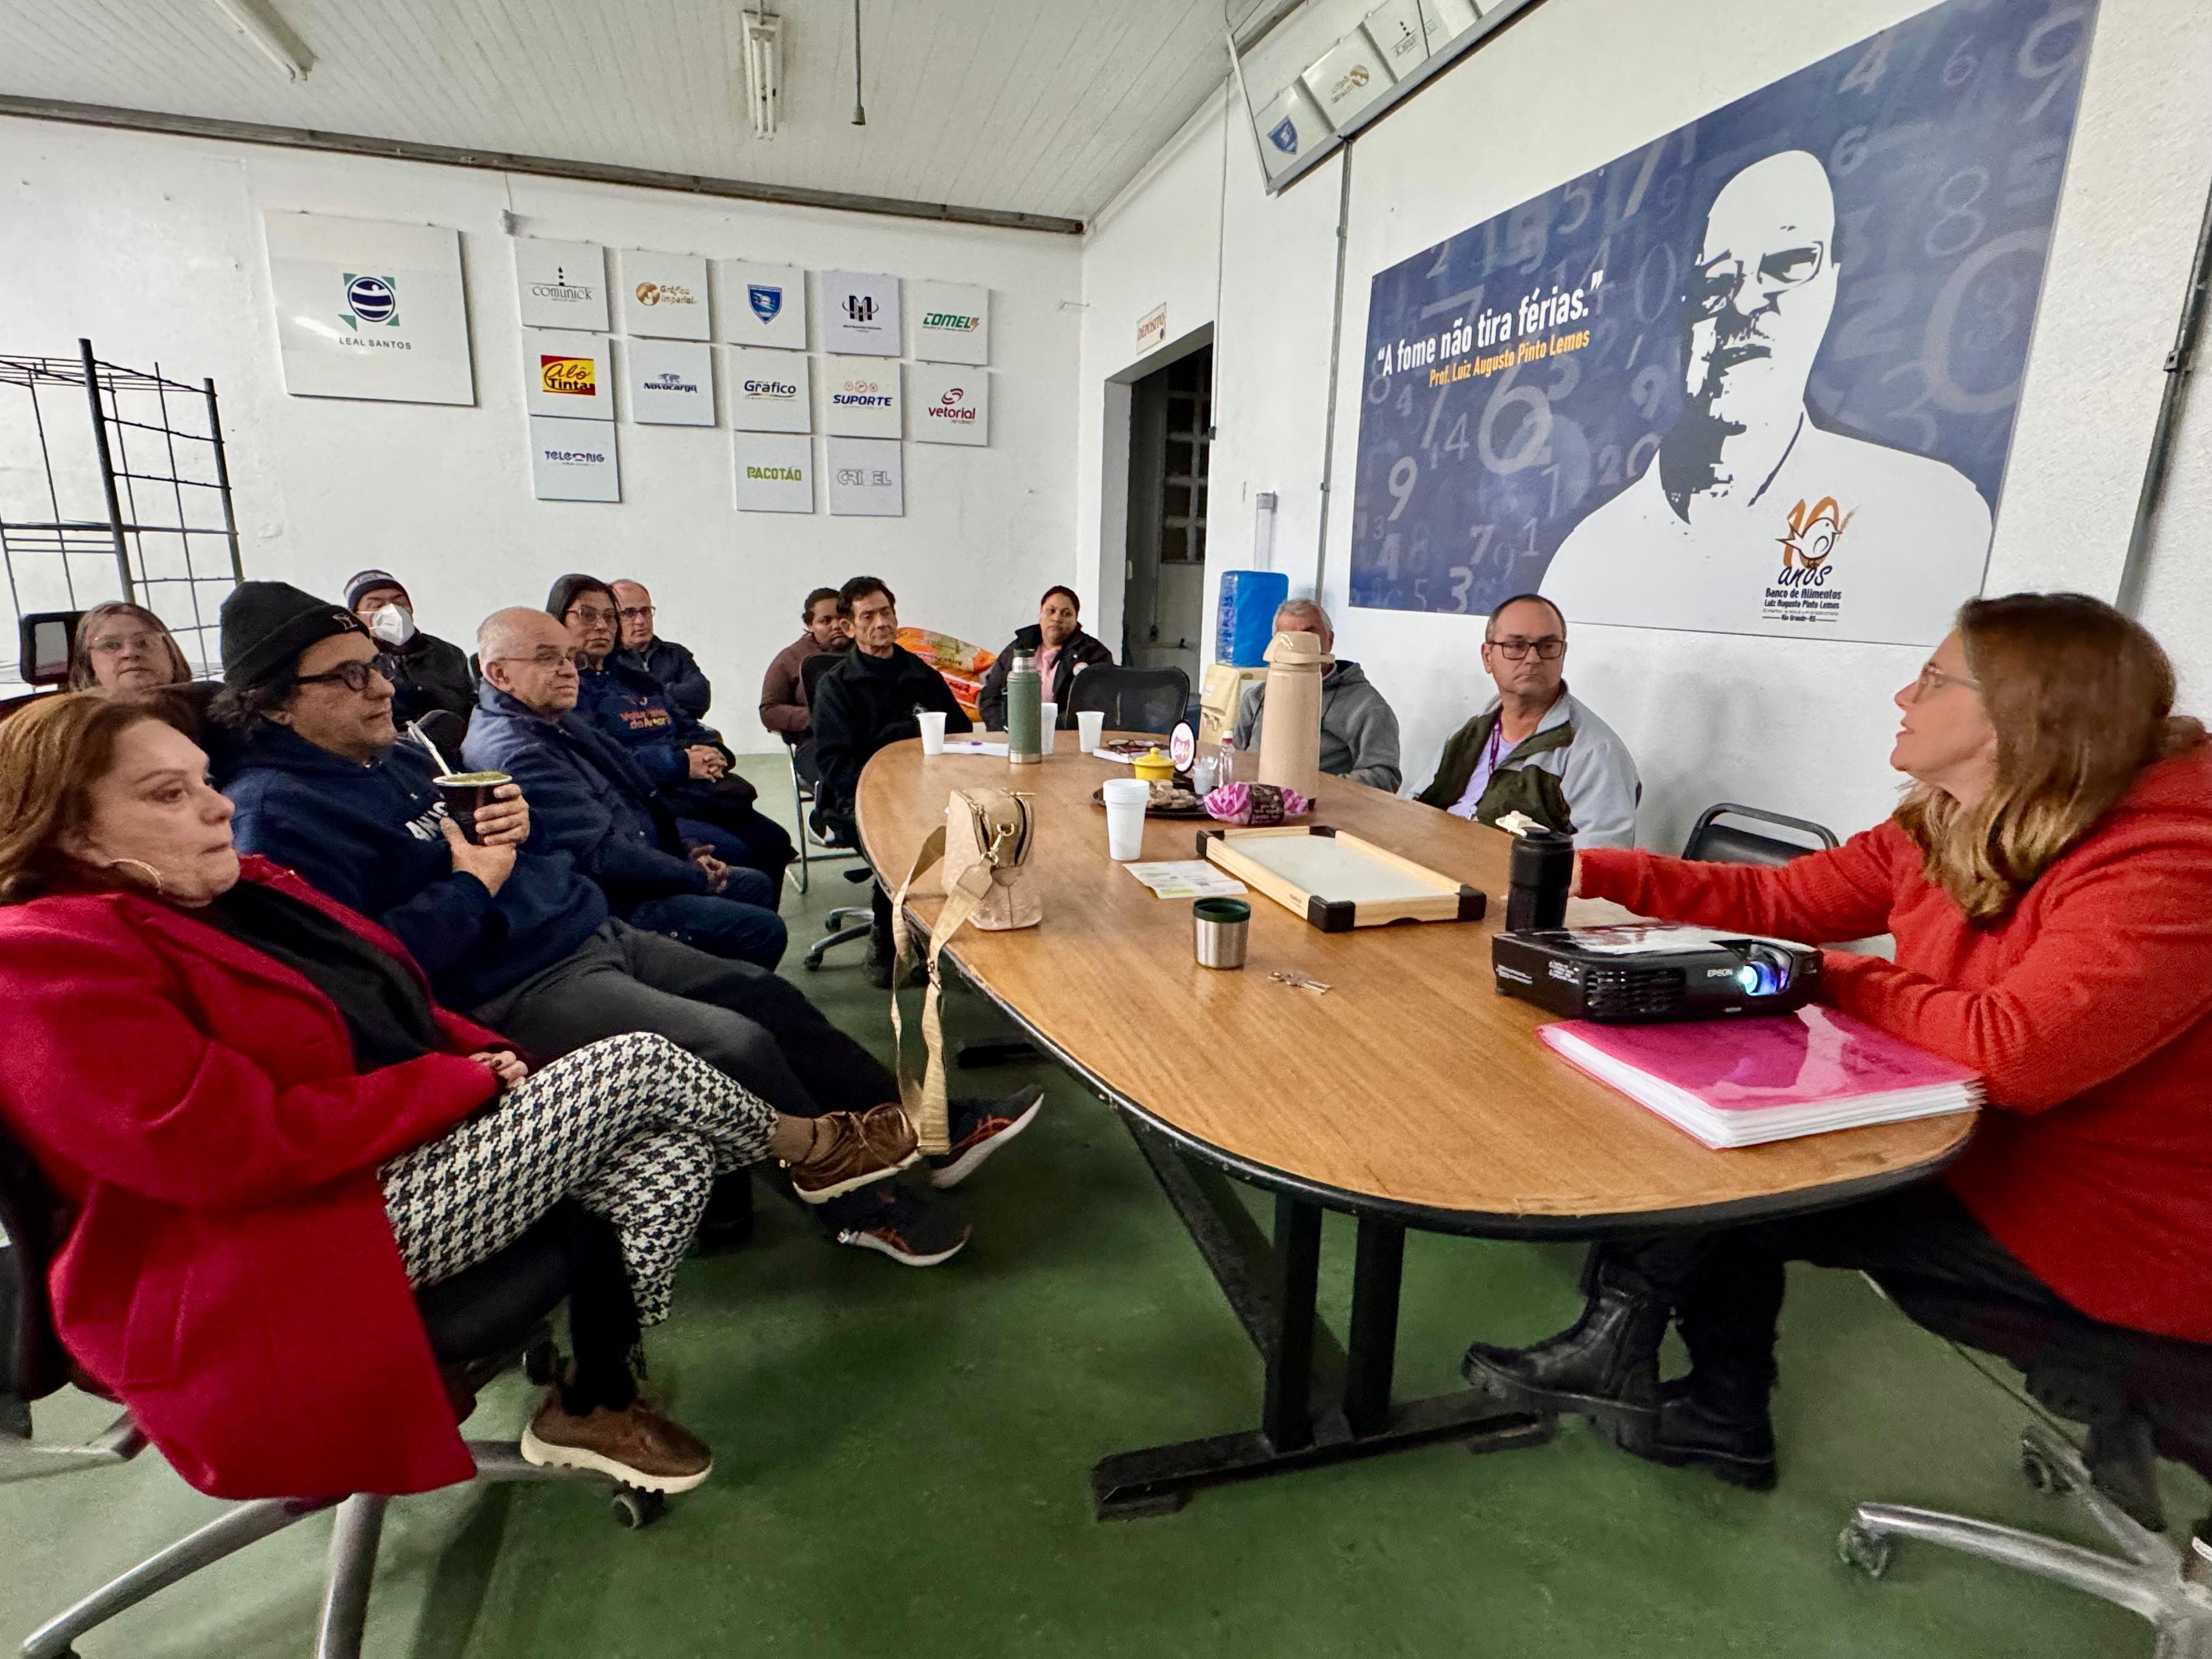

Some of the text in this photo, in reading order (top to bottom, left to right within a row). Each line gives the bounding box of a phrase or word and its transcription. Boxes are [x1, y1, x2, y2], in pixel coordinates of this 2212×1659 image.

[923, 313, 971, 329] COMEL
[339, 337, 412, 350] LEAL SANTOS
[1397, 337, 1436, 374] fome
[1440, 318, 1473, 360] não
[1478, 308, 1513, 348] tira
[1429, 330, 1590, 388] Prof. Luiz Augusto Pinto Lemos
[833, 394, 893, 407] SUPORTE
[928, 407, 976, 420] vetorial
[1778, 565, 1833, 588] anos
[1765, 588, 1842, 600] Banco de Alimentos
[1707, 968, 1733, 978] EPSON
